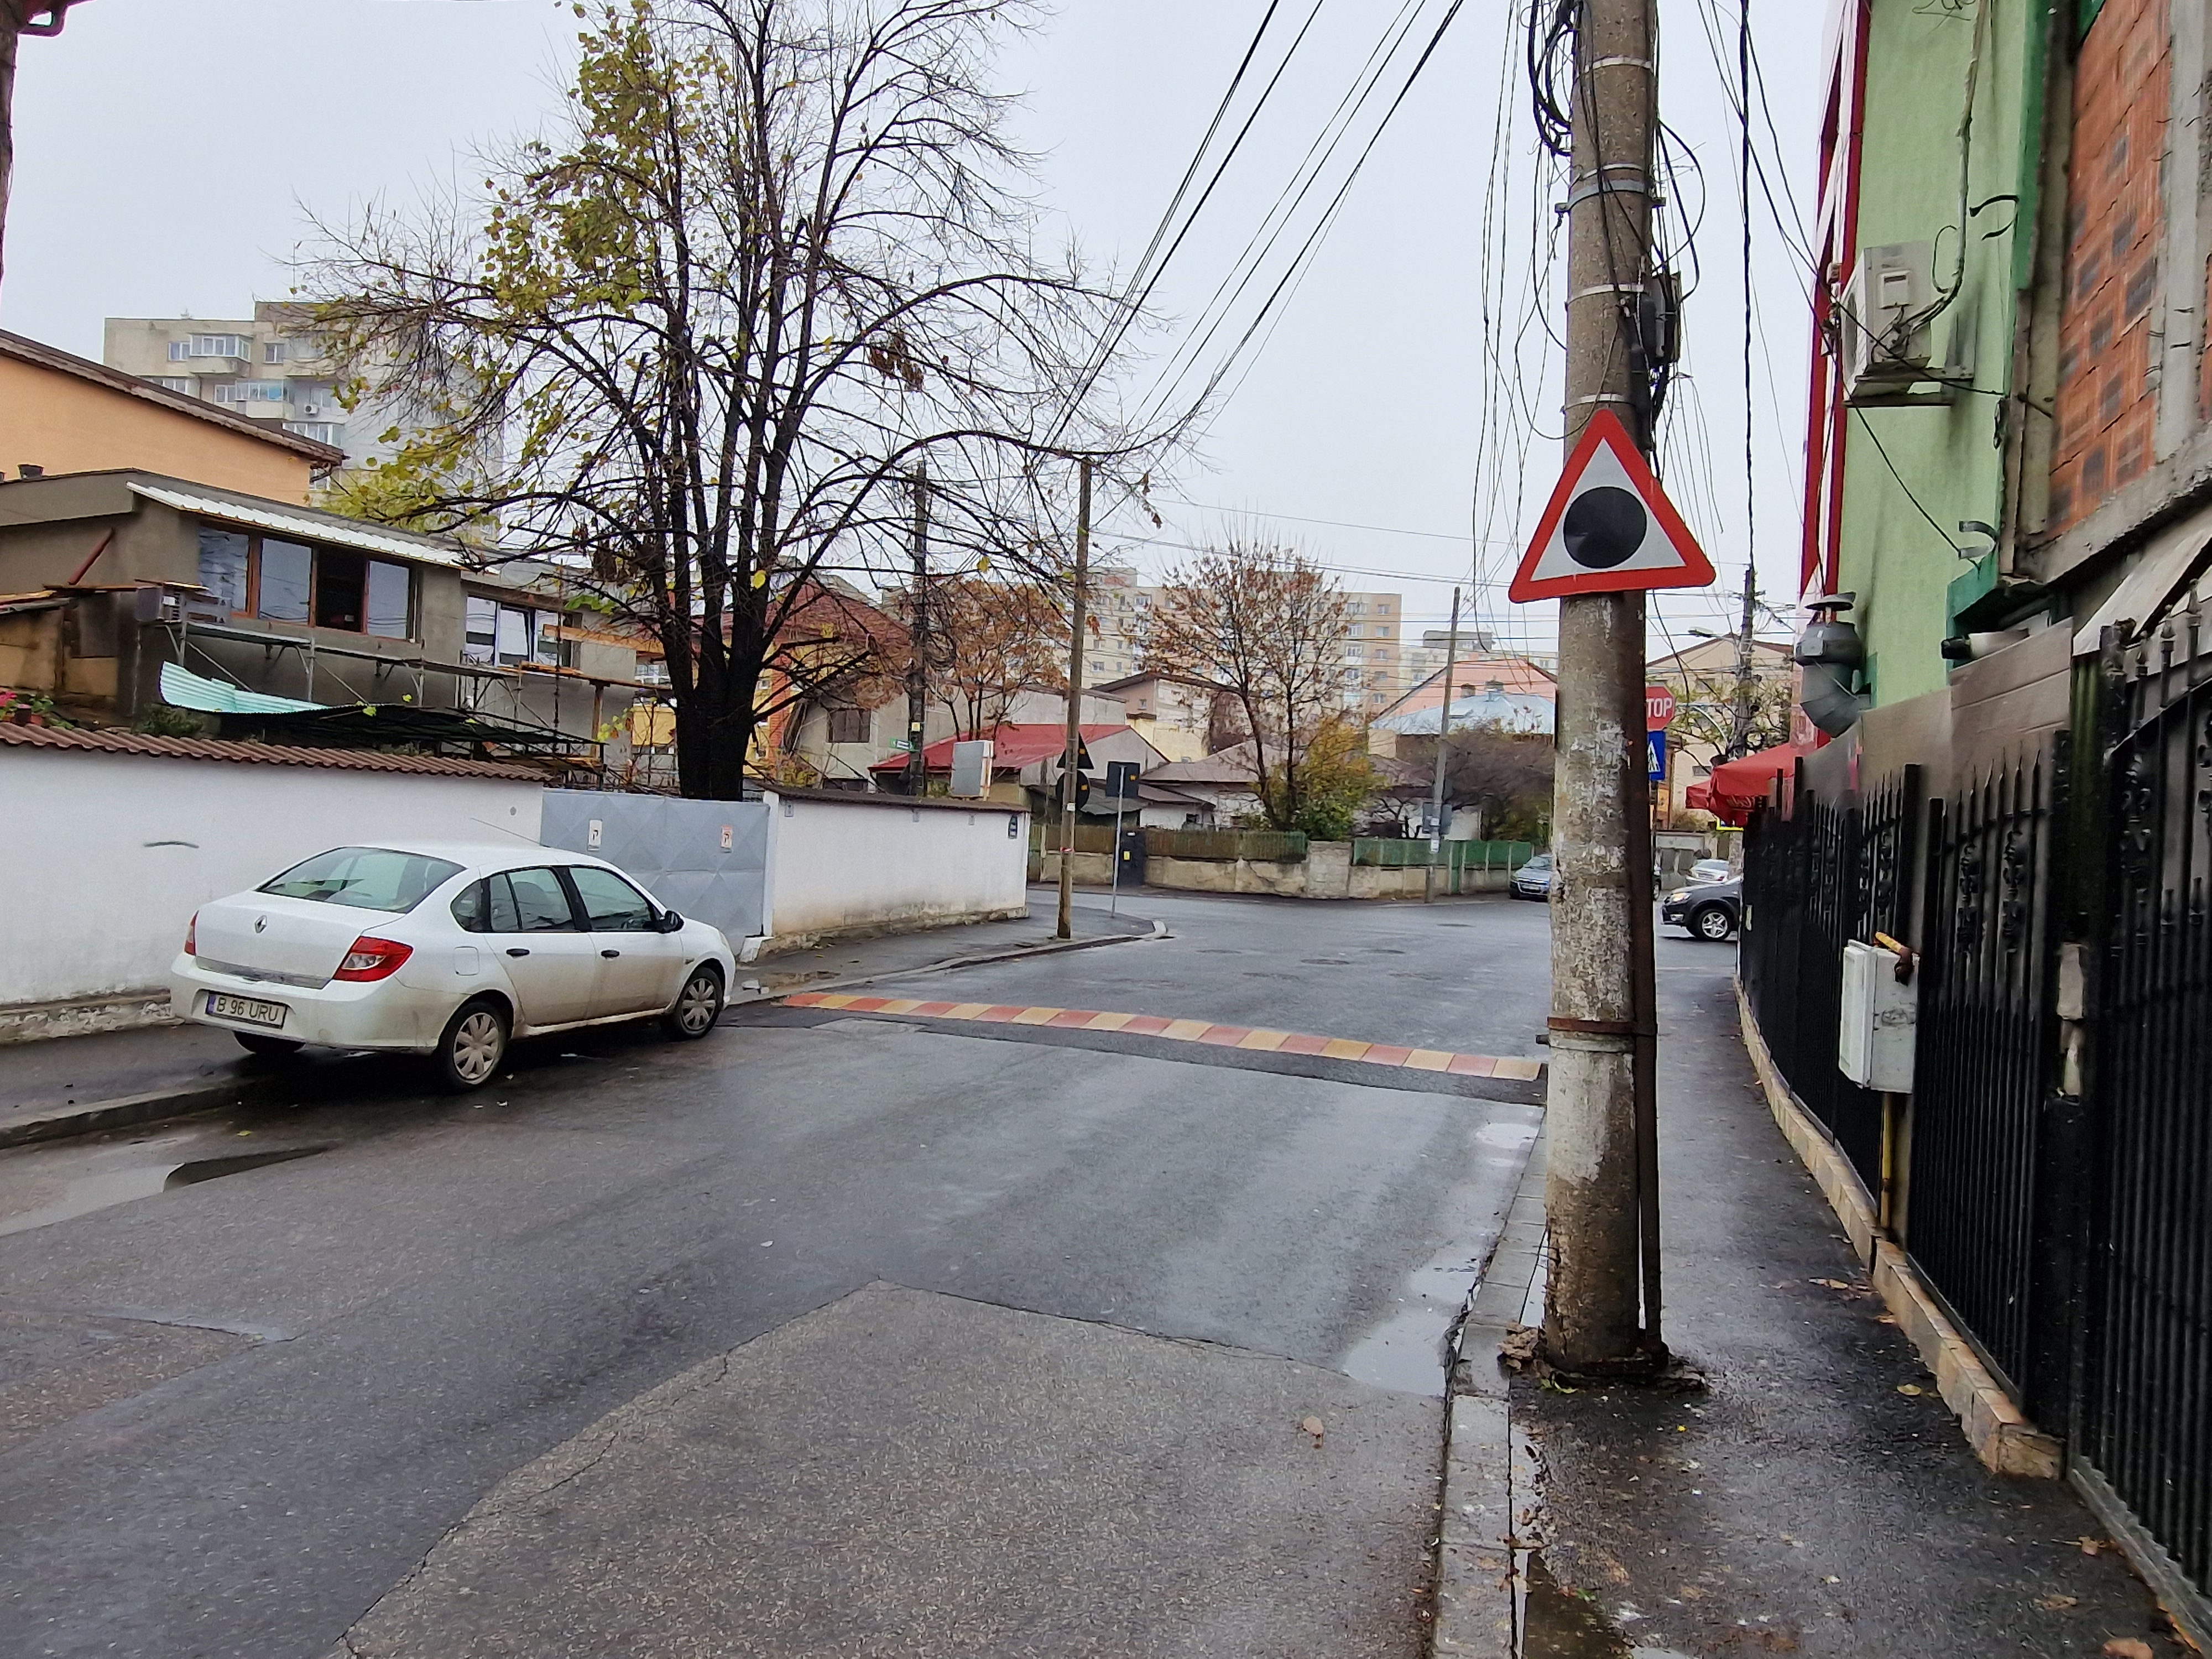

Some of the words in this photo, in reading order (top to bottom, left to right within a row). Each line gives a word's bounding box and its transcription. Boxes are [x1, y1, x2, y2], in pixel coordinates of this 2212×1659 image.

[1646, 697, 1673, 718] TOP
[216, 997, 227, 1012] B
[230, 999, 245, 1015] 96
[249, 1003, 279, 1021] URU
